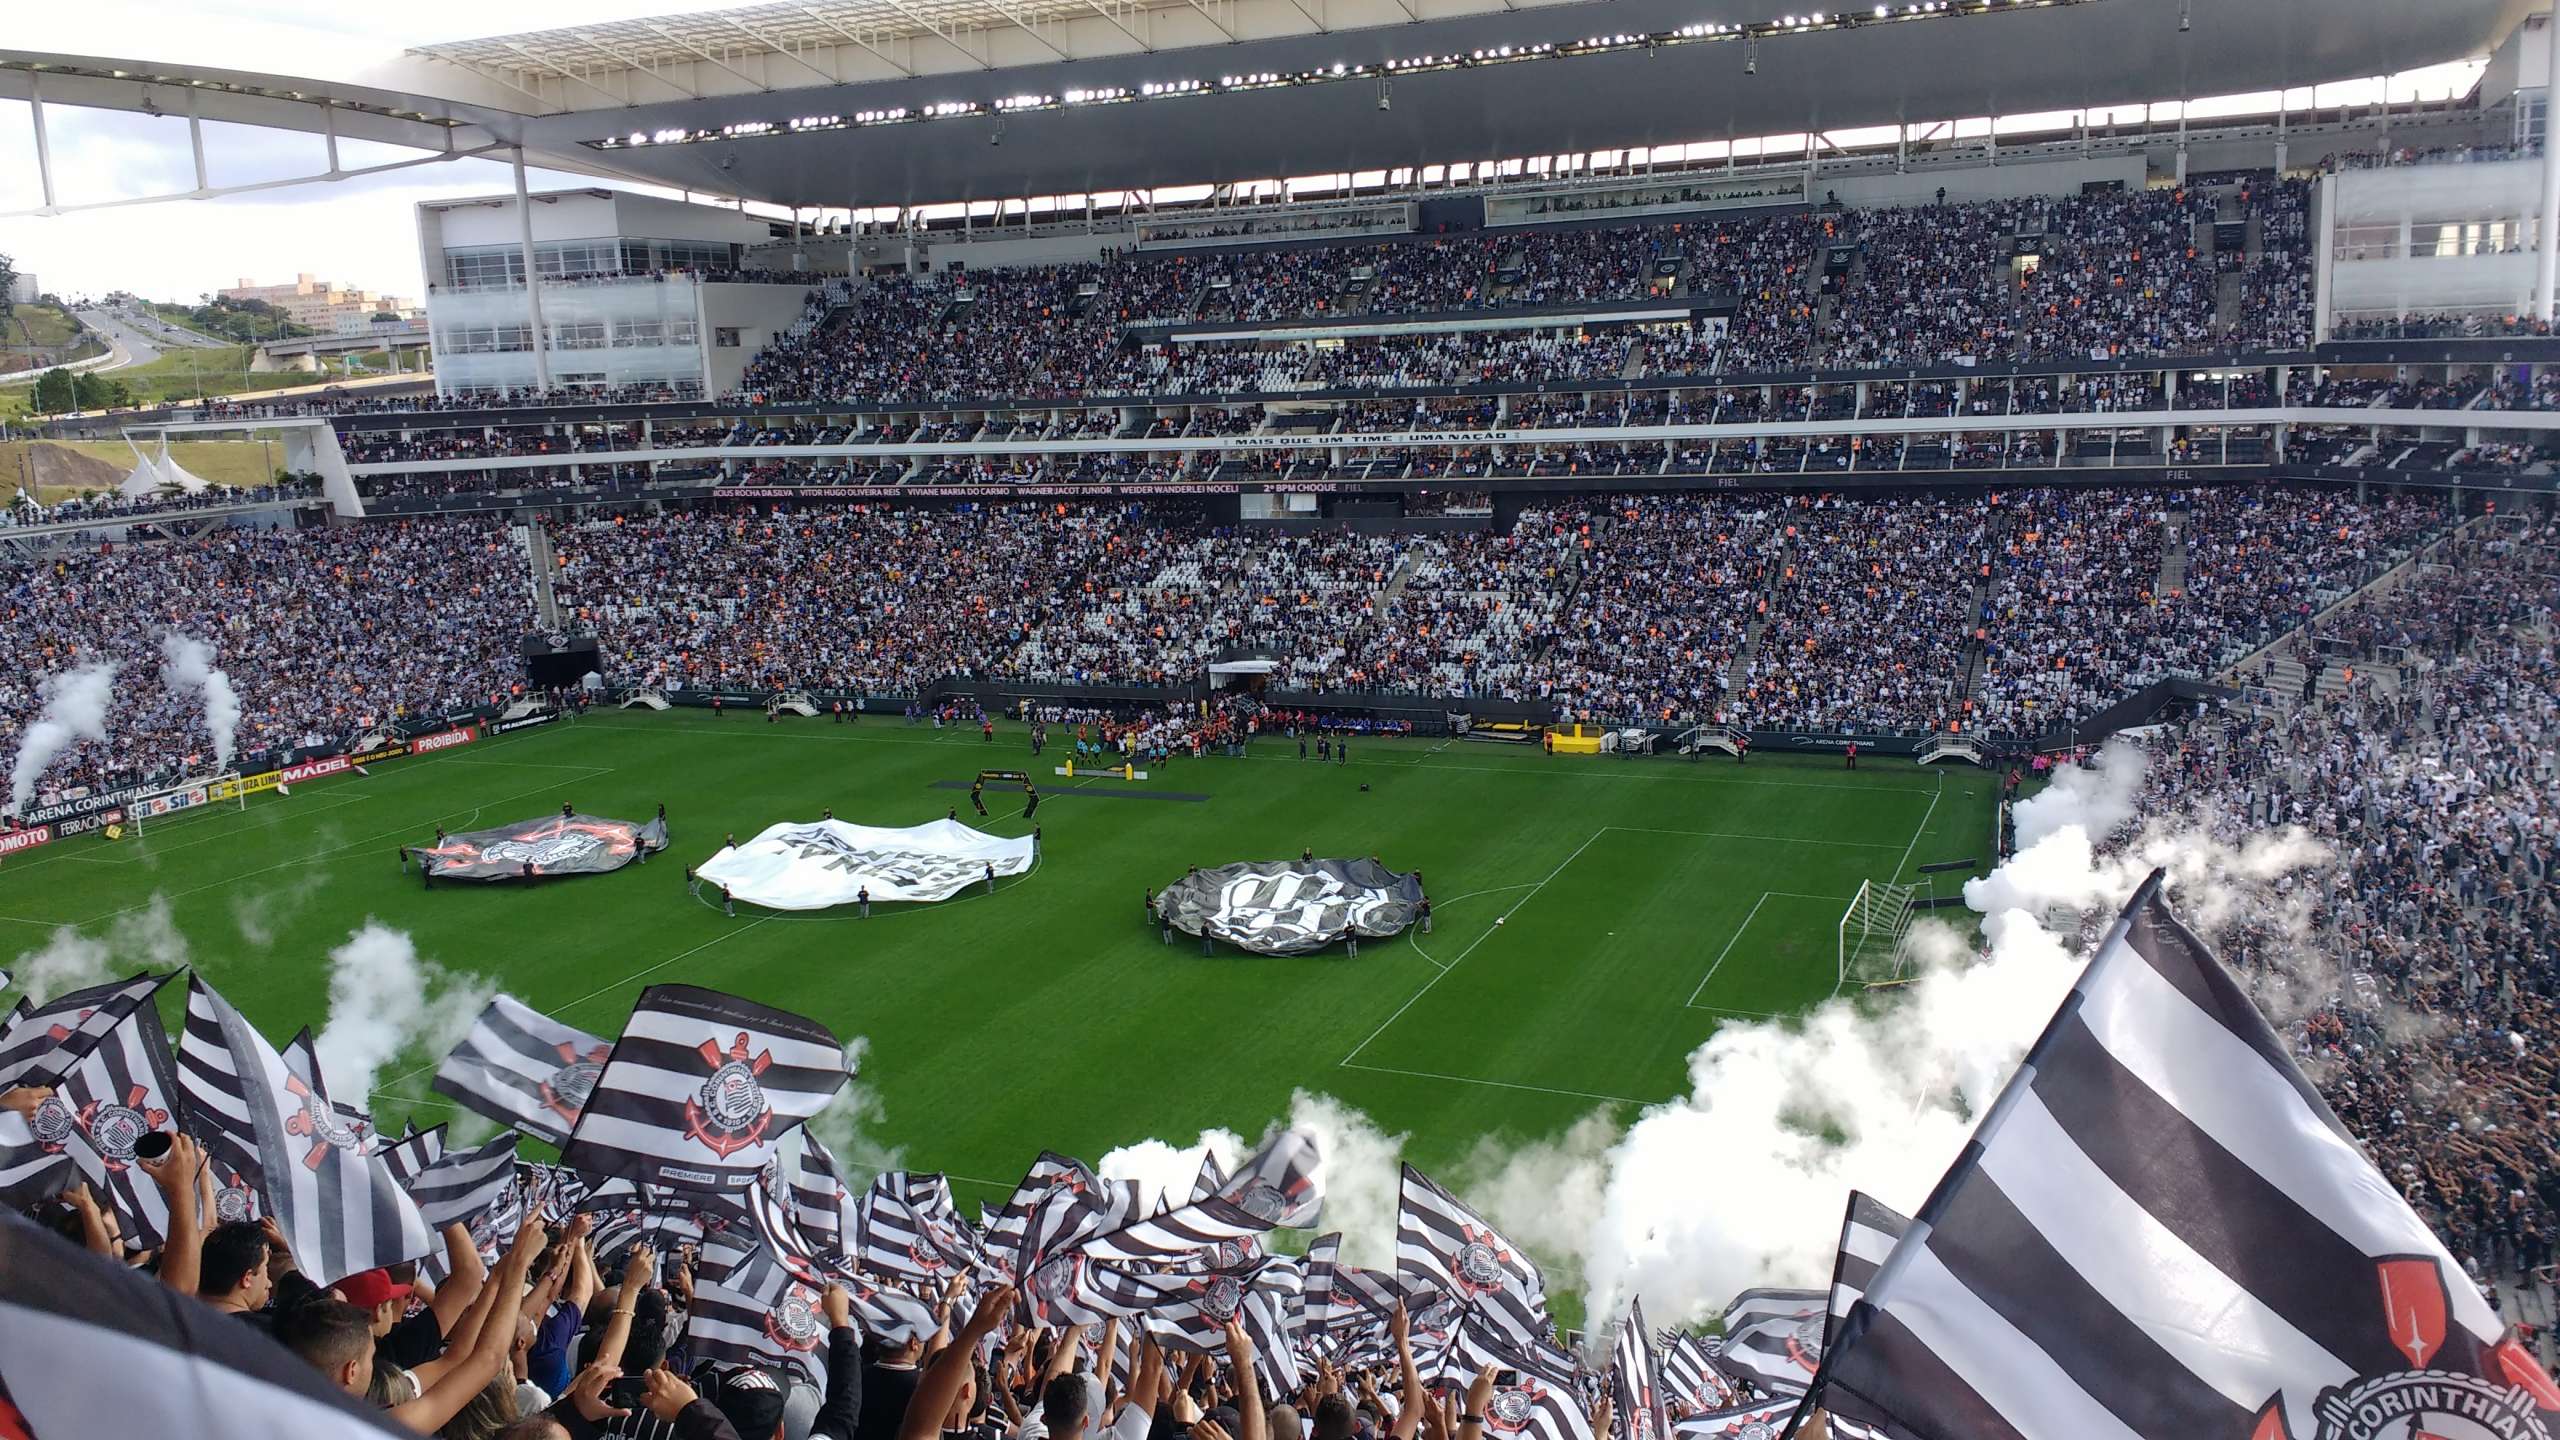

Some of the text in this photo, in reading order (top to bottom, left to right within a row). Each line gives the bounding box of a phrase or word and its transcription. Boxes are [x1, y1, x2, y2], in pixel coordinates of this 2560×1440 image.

[1448, 431, 1507, 441] NAÇÃO
[1235, 438, 1274, 446] MAIS
[1280, 437, 1313, 445] QUE
[2166, 470, 2192, 480] FIEL
[1718, 478, 1740, 487] FIEL
[907, 487, 1010, 496] VIVIANE MARIA DO CARMO
[1017, 486, 1113, 495] WAGNER JACOT JUNIOR
[1120, 484, 1239, 494] WEIDER WANDERLEI NOCELI
[1275, 484, 1296, 492] BPM
[1296, 483, 1337, 492] CHOQUE
[1344, 483, 1363, 492] FIEL
[735, 489, 761, 497] ROCHA
[761, 489, 773, 497] DA
[773, 489, 794, 497] SILVA
[800, 488, 901, 497] VITOR HUGO OLIVEIRA REIS
[283, 758, 351, 782] MADEL
[260, 773, 282, 787] LIMA
[27, 782, 161, 824] ARENA CORINTHIANS
[60, 812, 107, 836] FERRACINI
[661, 1167, 714, 1183] PREMIERE
